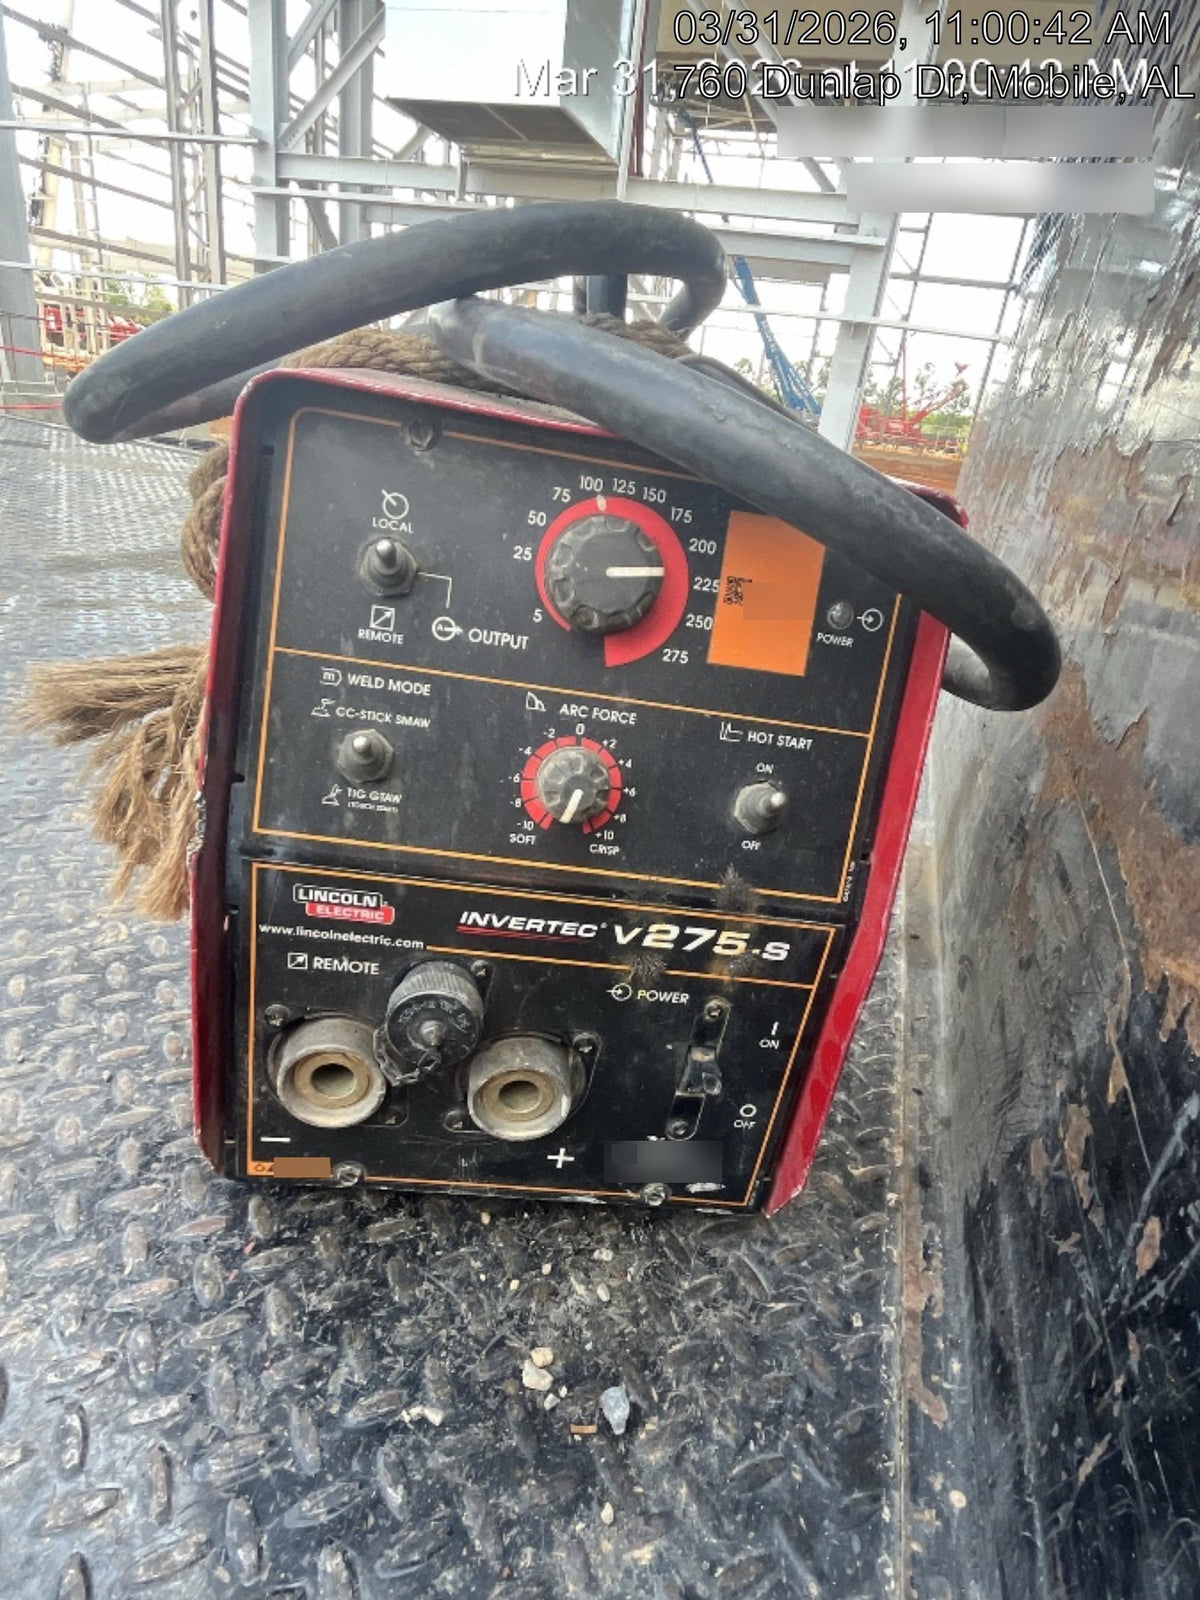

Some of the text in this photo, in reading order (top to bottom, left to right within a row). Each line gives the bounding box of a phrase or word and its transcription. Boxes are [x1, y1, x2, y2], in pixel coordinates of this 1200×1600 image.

[580, 475, 604, 492] 100
[613, 478, 636, 495] 125
[552, 486, 572, 503] 75
[643, 487, 667, 503] 150
[527, 510, 547, 527] 50
[671, 506, 693, 523] 175
[372, 517, 414, 534] LOCAL
[513, 545, 533, 561] 25
[689, 538, 717, 555] 200
[693, 577, 720, 593] 225
[532, 609, 543, 623] 5
[685, 614, 713, 631] 250
[358, 628, 405, 645] REMOTE
[468, 627, 529, 650] OUTPUT
[816, 632, 854, 648] POWER
[662, 648, 689, 664] 275
[347, 672, 432, 696] WELD MODE
[335, 706, 431, 729] CC-STICK SMAW
[559, 703, 637, 725] ARC FORCE
[543, 728, 556, 739] -2
[576, 722, 586, 735] 0
[602, 738, 617, 749] +2
[747, 730, 813, 751] HOT START
[518, 746, 532, 756] -4
[618, 758, 632, 768] +4
[756, 762, 775, 774] ON
[508, 773, 520, 783] -6
[347, 786, 367, 800] TIG
[509, 833, 536, 846] SOFT
[595, 830, 614, 841] +10
[589, 843, 620, 856] CRISP
[741, 840, 761, 851] OFF
[298, 888, 377, 908] LINCOLN
[316, 904, 385, 921] ELECTRIC
[258, 923, 424, 949] www.lincolnelectric.com
[614, 923, 791, 961] V275-S
[313, 955, 380, 975] REMOTE
[637, 989, 690, 1005] POWER
[759, 1038, 780, 1050] ON
